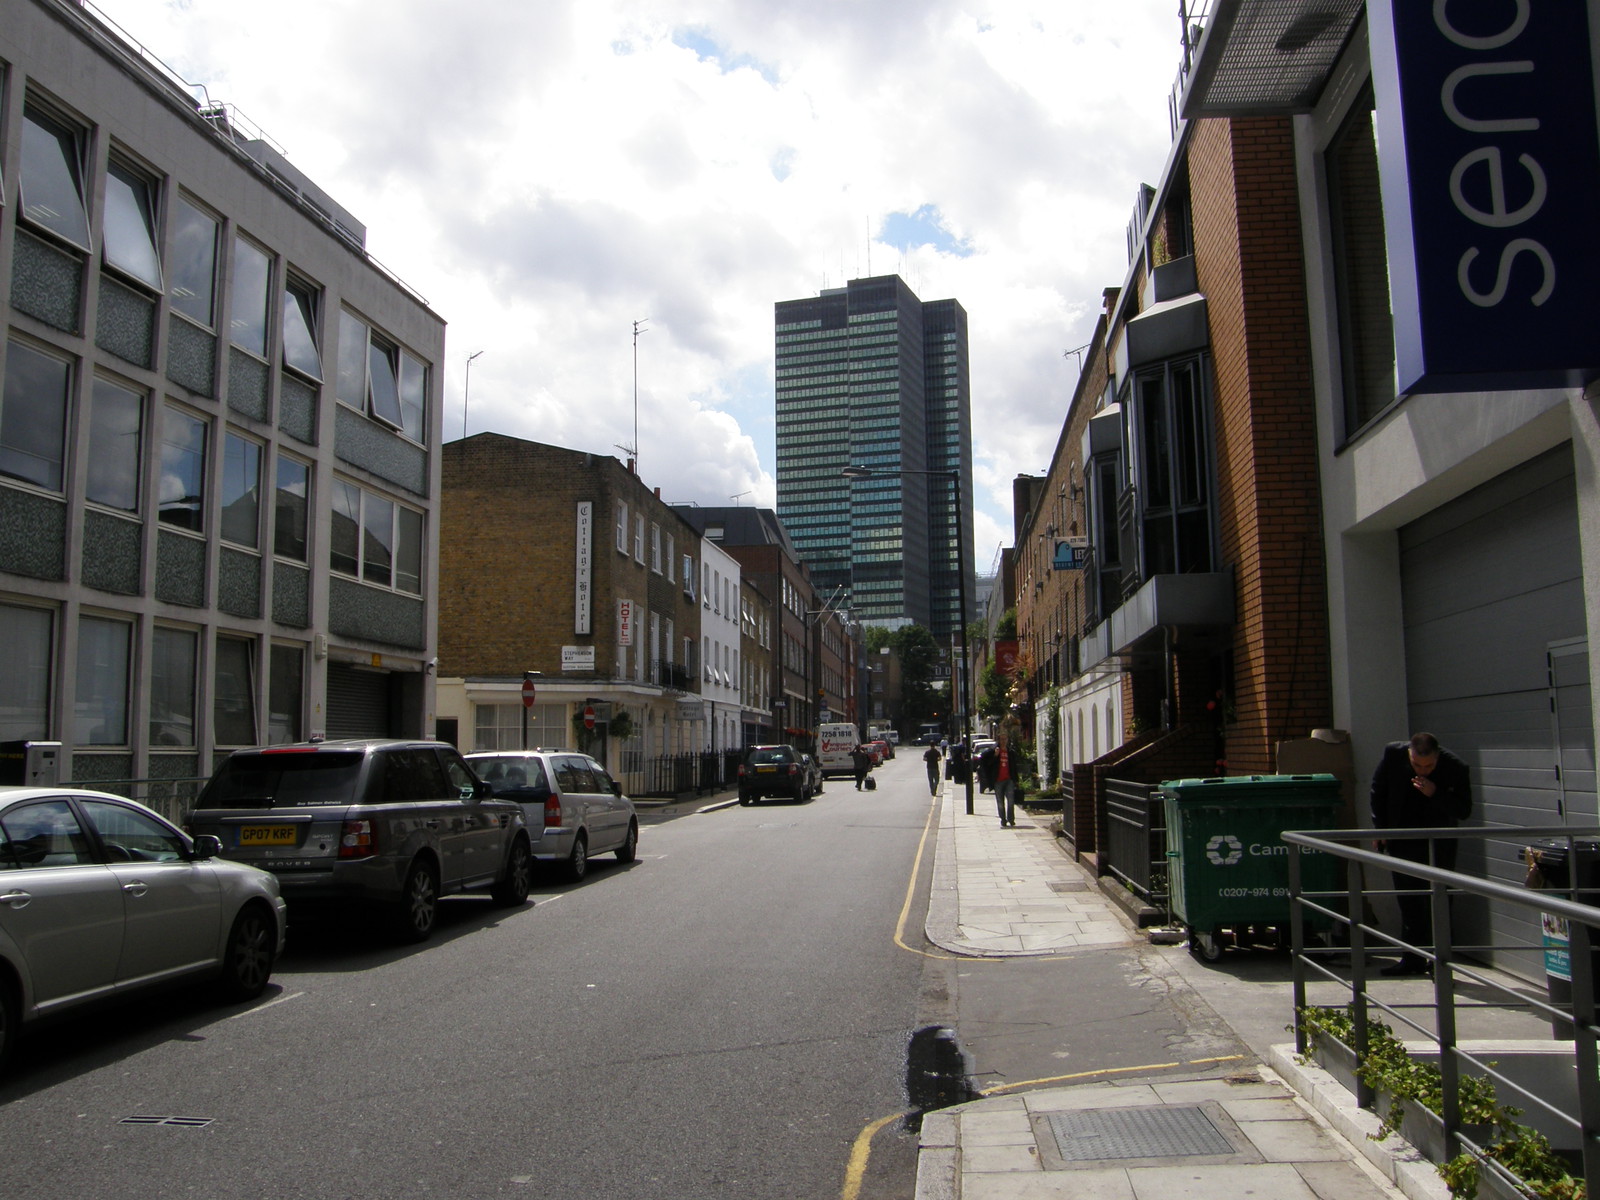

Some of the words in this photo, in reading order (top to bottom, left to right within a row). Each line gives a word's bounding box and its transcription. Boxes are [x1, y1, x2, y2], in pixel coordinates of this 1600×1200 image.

[579, 581, 587, 632] Hotel
[620, 602, 630, 637] HOTEL
[242, 829, 270, 840] GP07
[272, 828, 294, 840] KRF
[1249, 844, 1323, 855] Camen
